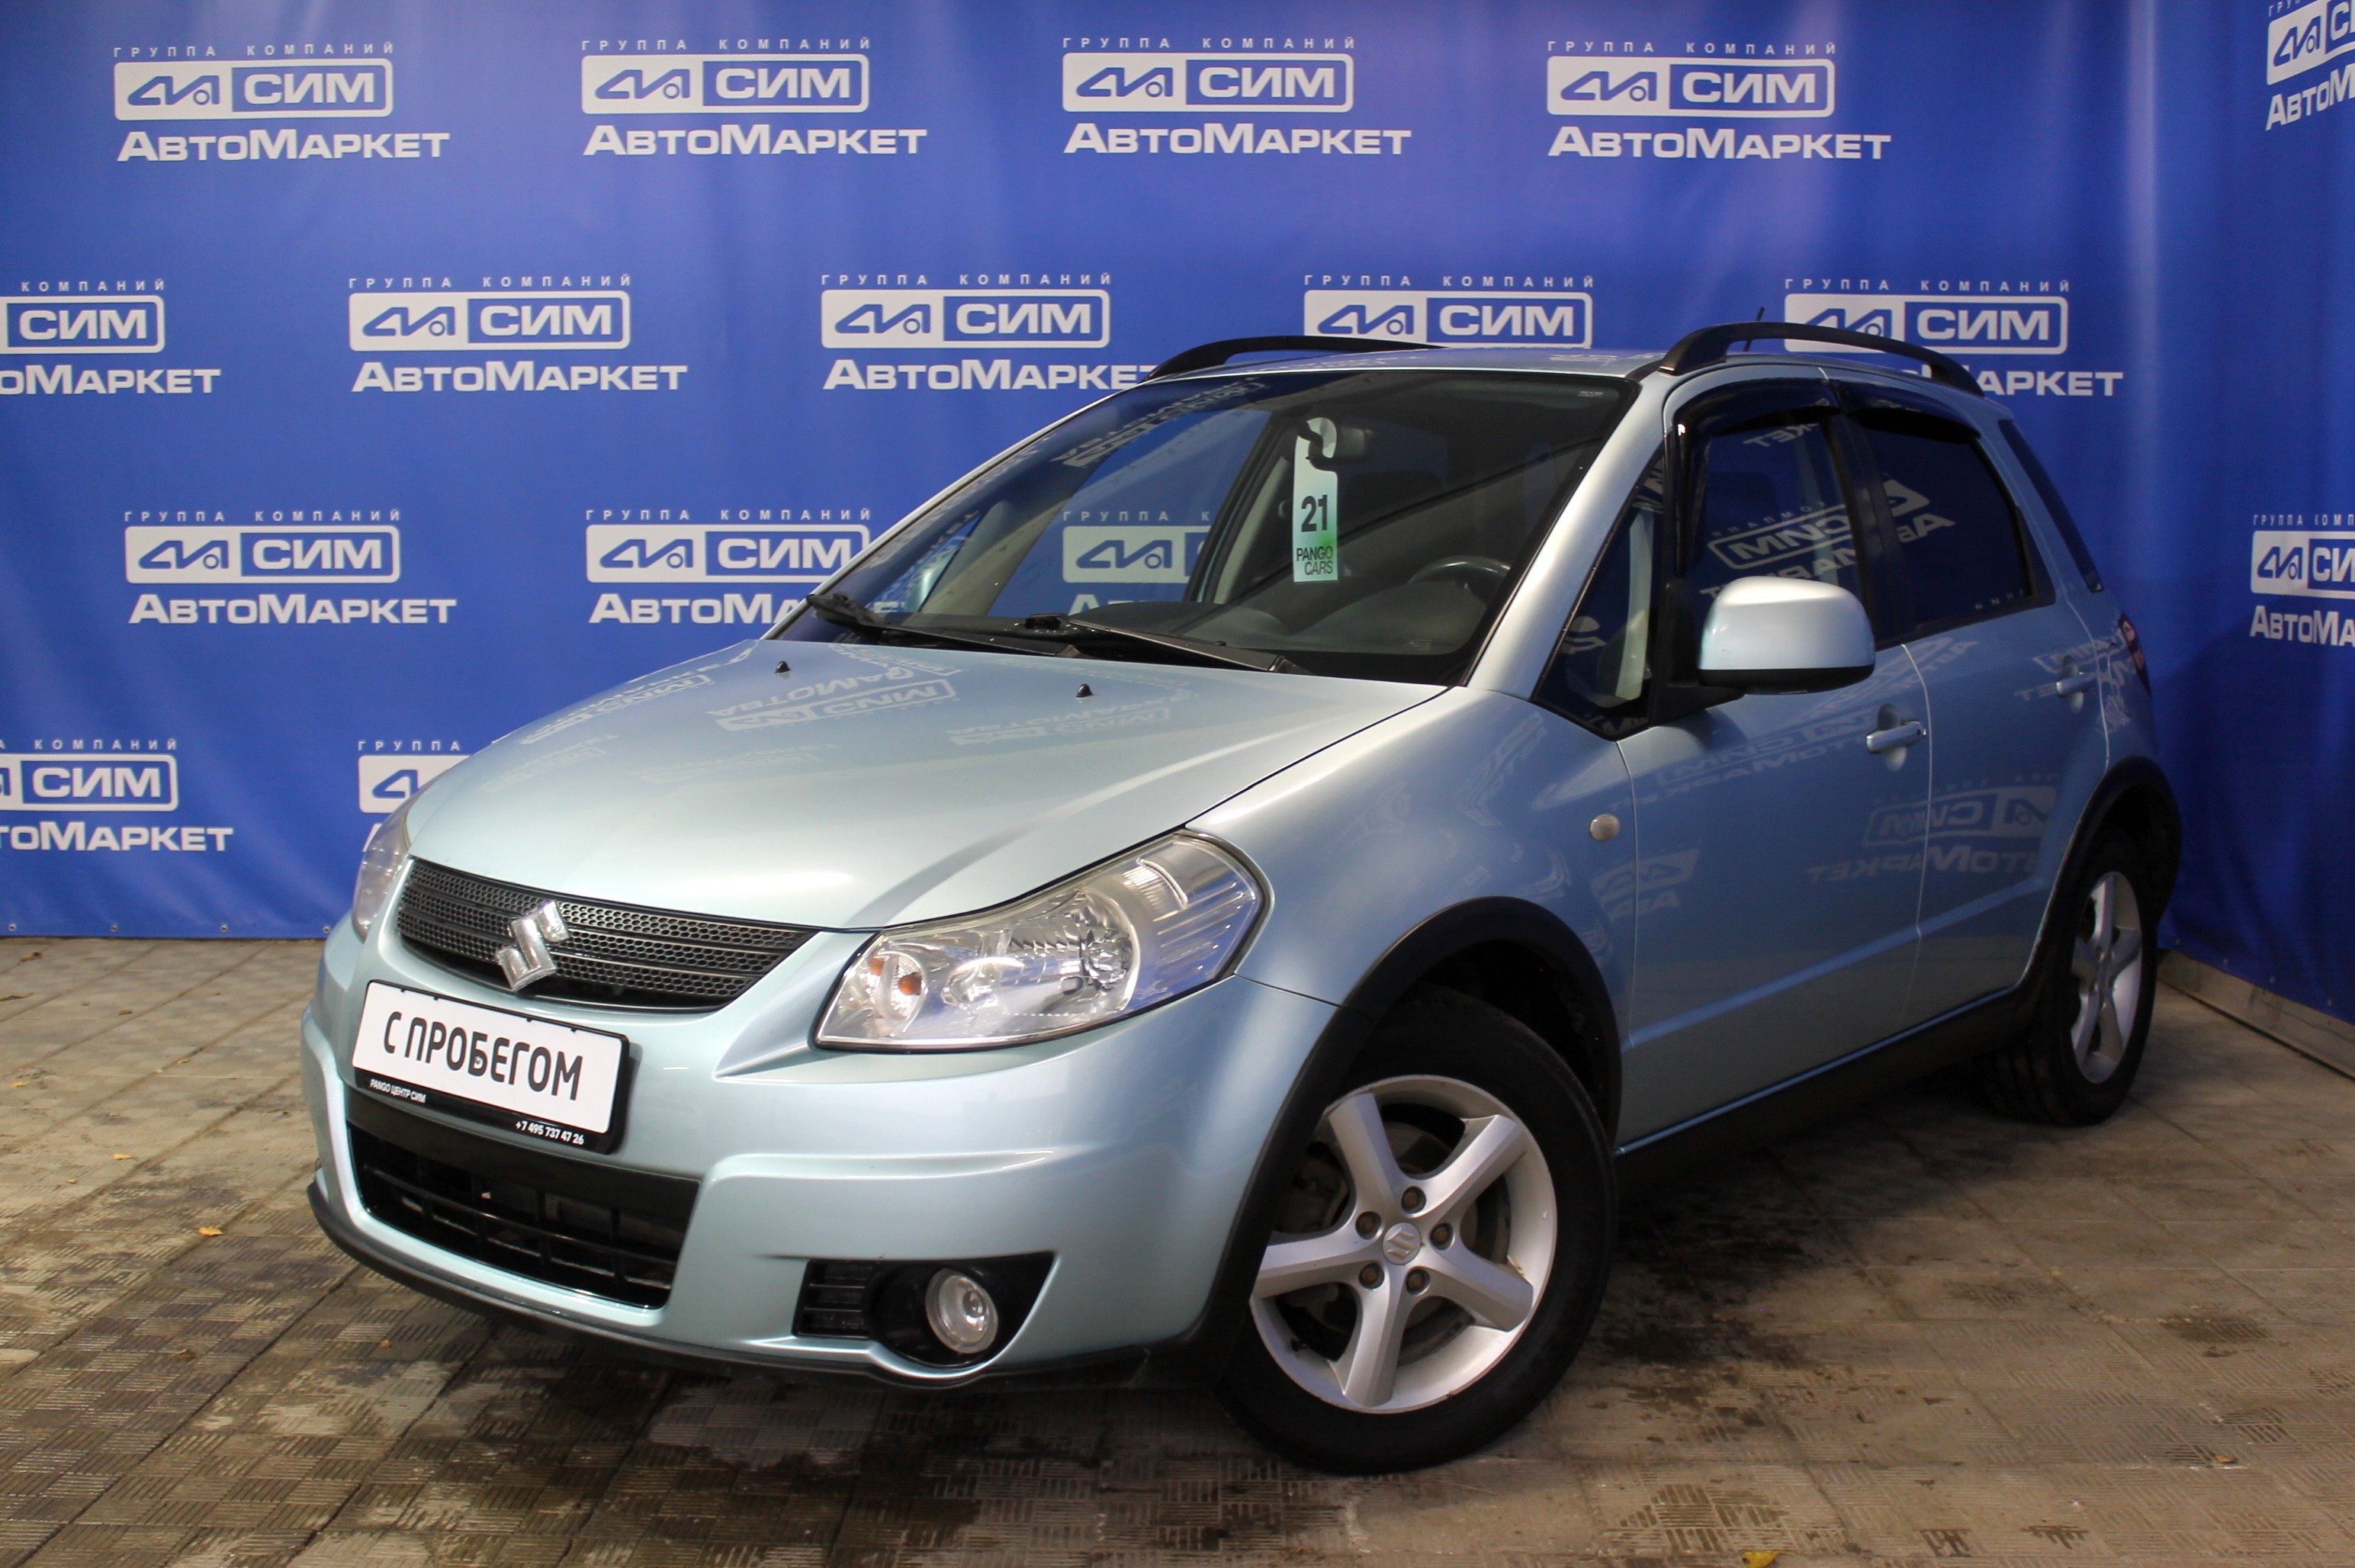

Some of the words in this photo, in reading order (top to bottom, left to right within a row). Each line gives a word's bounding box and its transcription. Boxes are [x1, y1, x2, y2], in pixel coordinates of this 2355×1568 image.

[114, 46, 215, 57] ГРУППА
[247, 42, 393, 55] КОМПАНИЙ
[582, 40, 686, 50] ГРУППА
[719, 37, 869, 50] КОМПАНИЙ
[1063, 37, 1169, 47] ГРУППА
[1203, 37, 1354, 49] КОМПАНИЙ
[1548, 41, 1653, 52] ГРУППА
[1687, 42, 1836, 55] КОМПАНИЙ
[245, 73, 374, 104] СИМ
[716, 69, 849, 98] СИМ
[1200, 67, 1334, 98] СИМ
[1683, 72, 1816, 103] СИМ
[21, 278, 164, 291] КОМПАНИЙ
[349, 277, 451, 288] ГРУППА
[483, 274, 630, 287] КОМПАНИЙ
[821, 275, 927, 284] ГРУППА
[960, 273, 1110, 284] КОМПАНИЙ
[1305, 275, 1410, 285] ГРУППА
[1443, 276, 1593, 287] КОМПАНИЙ
[1785, 278, 1888, 290] ГРУППА
[1921, 280, 2069, 291] КОМПАНИЙ
[20, 310, 146, 339] СИМ
[480, 305, 611, 336] СИМ
[956, 304, 1090, 333] СИМ
[1440, 305, 1573, 336] СИМ
[1918, 310, 2048, 339] СИМ
[125, 511, 223, 522] ГРУППА
[255, 509, 399, 521] КОМПАНИЙ
[586, 509, 689, 520] ГРУППА
[721, 508, 869, 520] КОМПАНИЙ
[1062, 512, 1168, 521] ГРУППА
[1301, 494, 1328, 532] 21
[2254, 515, 2303, 525] ГРУППА
[253, 540, 381, 569] СИМ
[718, 538, 850, 568] СИМ
[1296, 545, 1333, 561] PANGO
[1305, 561, 1333, 575] CARS
[34, 739, 175, 750] КОМПАНИЙ
[358, 741, 459, 750] ГРУППА
[33, 767, 160, 797] СИМ
[384, 1011, 401, 1054] С
[404, 1017, 583, 1100] ПРОБЕГОМ
[370, 1078, 390, 1093] PANGO
[391, 1085, 410, 1099] ЦЕНТР
[410, 1091, 426, 1104] СИМ
[516, 1120, 528, 1131] +7
[529, 1123, 545, 1135] 495
[545, 1126, 561, 1139] 737
[561, 1130, 573, 1142] 47
[573, 1133, 584, 1145] 26
